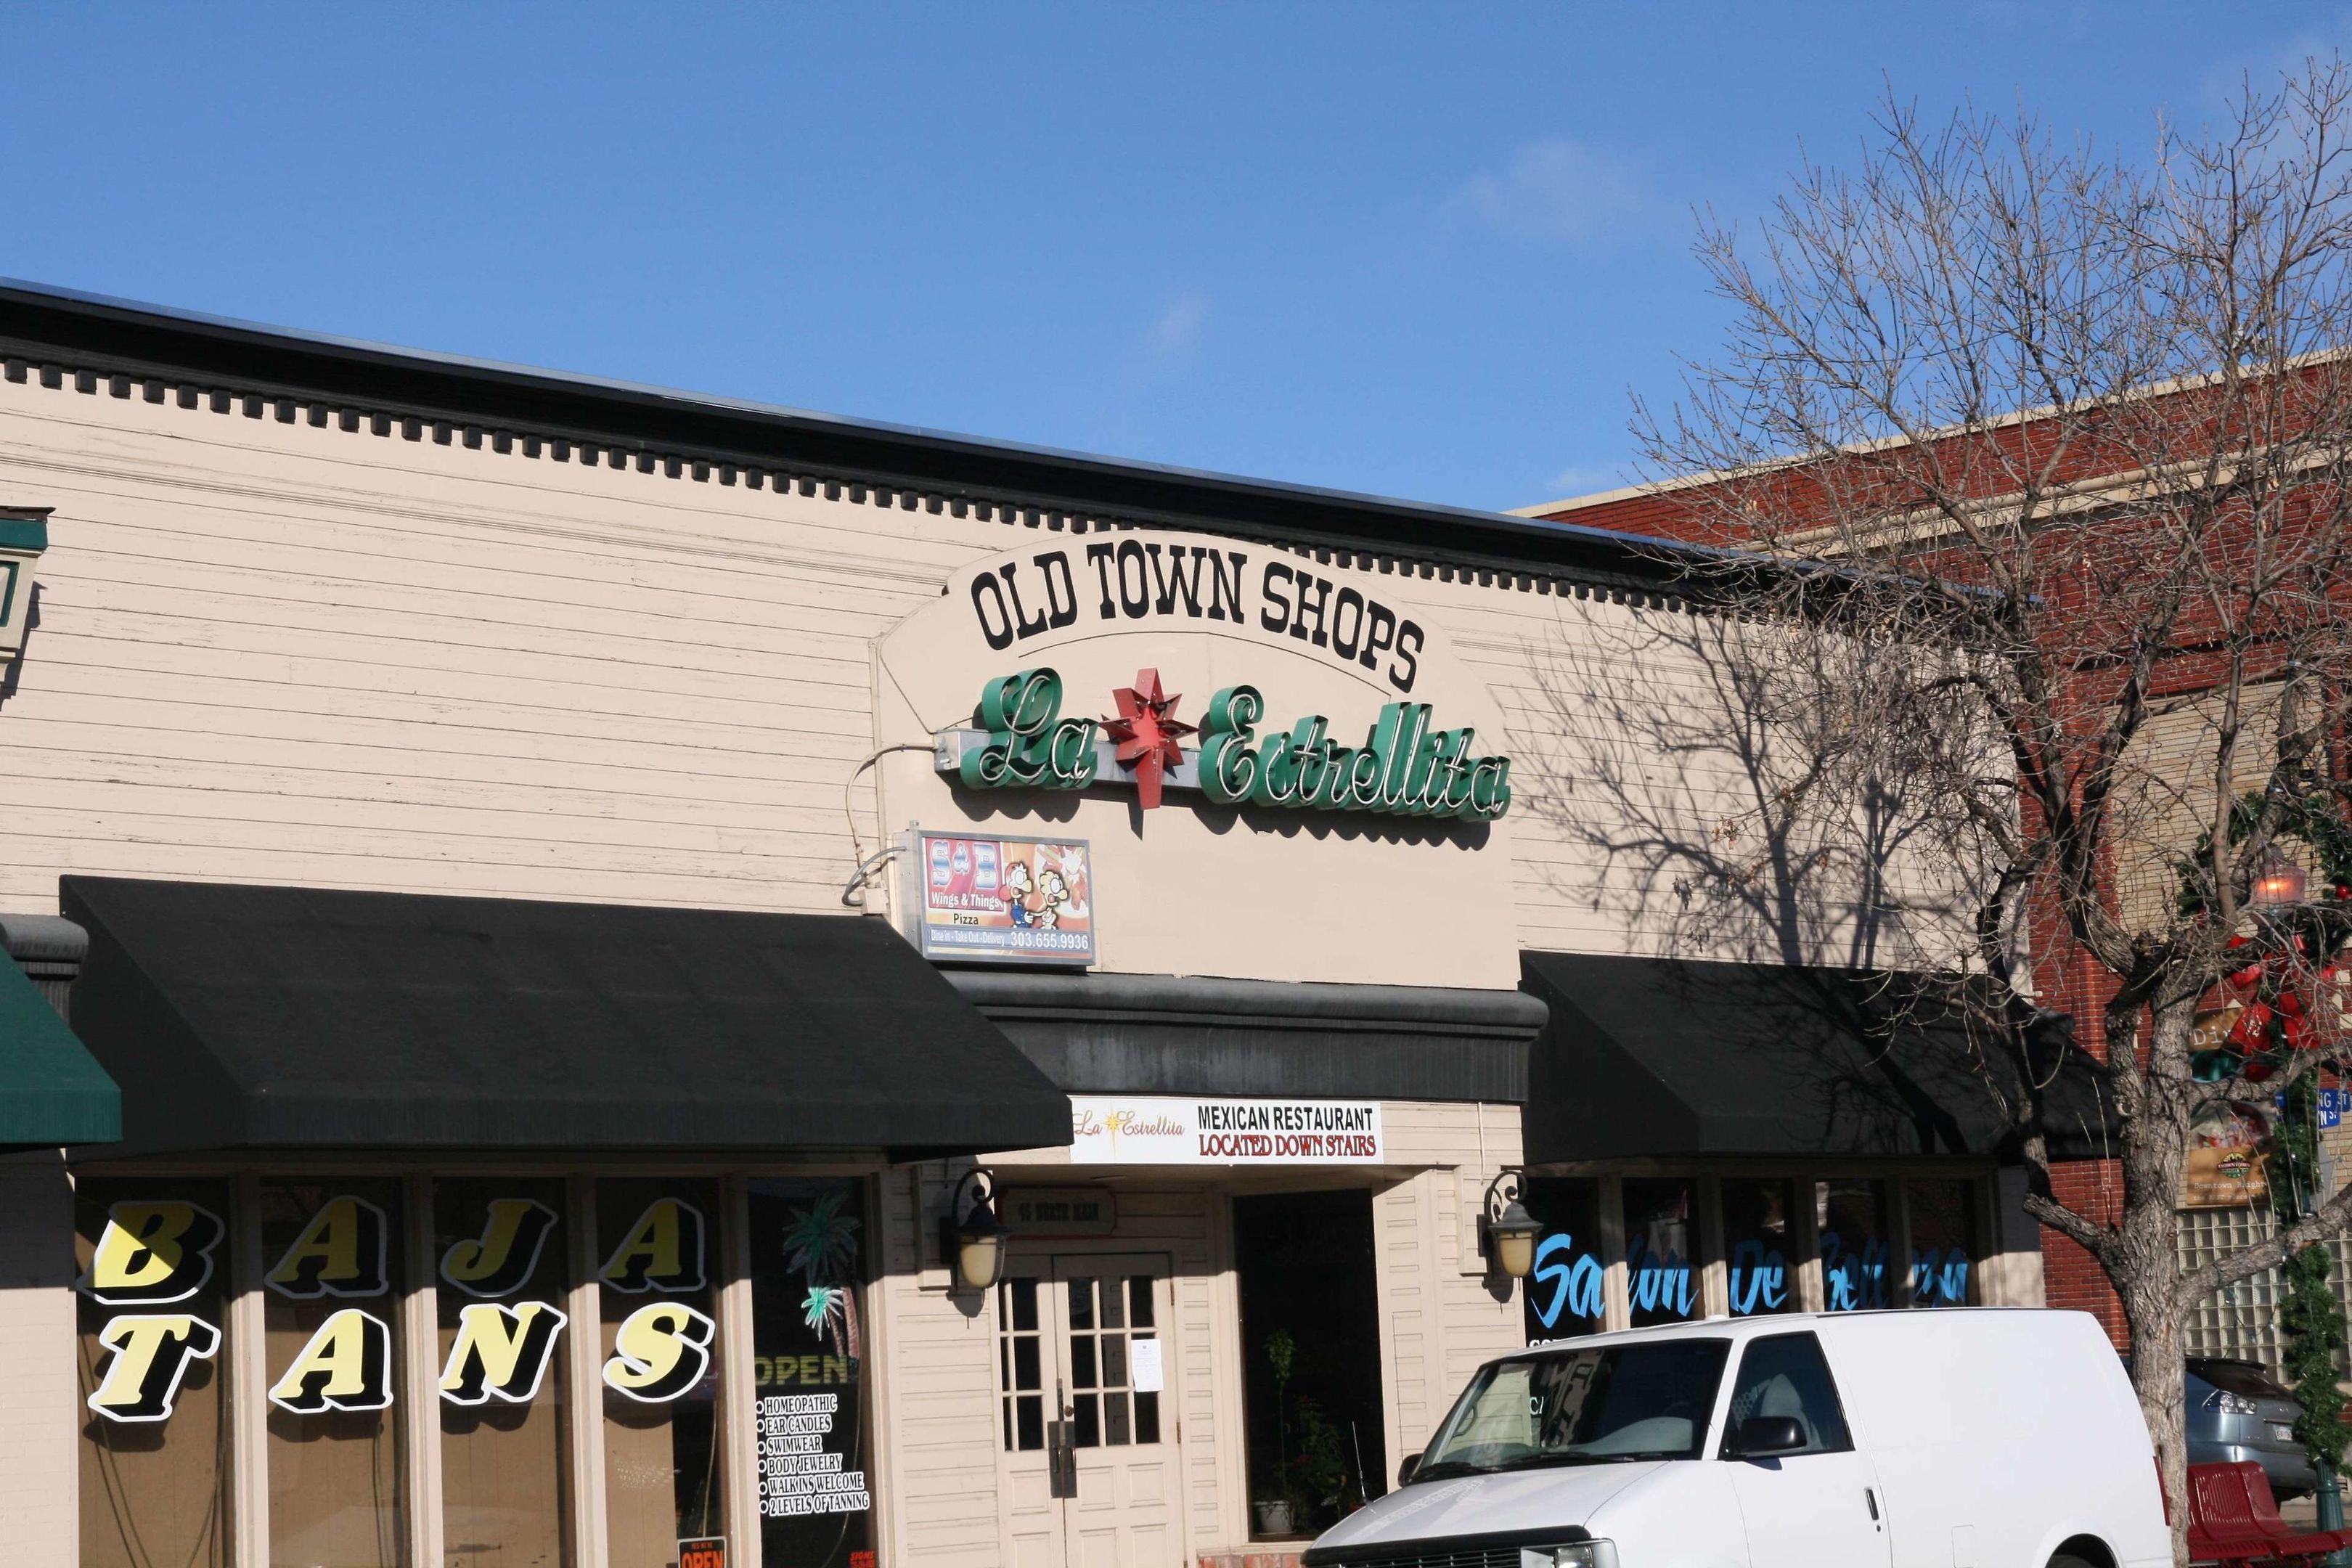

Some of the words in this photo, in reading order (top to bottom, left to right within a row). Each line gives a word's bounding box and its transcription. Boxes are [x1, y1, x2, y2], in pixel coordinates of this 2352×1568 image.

[971, 550, 1078, 651] OLD
[1087, 539, 1247, 624] TOWN
[1260, 561, 1425, 694] SHOPS
[960, 667, 1097, 791] La
[931, 841, 951, 886] S
[952, 842, 971, 873] &
[973, 843, 997, 889] B
[932, 892, 959, 907] Wings
[961, 894, 968, 906] &
[971, 894, 1000, 910] Things
[953, 913, 979, 925] Pizza
[955, 931, 968, 942] Take
[968, 931, 979, 942] Out
[1010, 931, 1088, 950] 303.655.9936
[1073, 1110, 1102, 1135] La
[1117, 1111, 1185, 1135] Estrellita
[1198, 1106, 1269, 1130] MEXICAN
[1274, 1106, 1373, 1131] RESTAURANT
[1199, 1134, 1273, 1156] LOCATED
[1275, 1135, 1323, 1157] DOWN
[1326, 1135, 1377, 1156] STAIRS
[76, 1196, 706, 1304] BAJA
[1730, 1238, 1789, 1315] De
[88, 1302, 716, 1422] TANS
[755, 1355, 848, 1386] OPEN
[765, 1395, 837, 1414] HOMEOPATHIC
[766, 1417, 786, 1434] EAR
[788, 1415, 831, 1433] CANDLES
[767, 1436, 822, 1455] SWIMWEAR
[768, 1458, 797, 1475] BODY
[799, 1454, 842, 1474] JEWELRY
[769, 1477, 798, 1495] WALK
[799, 1475, 814, 1493] INS
[816, 1473, 863, 1490] WELCOME
[770, 1498, 777, 1515] 2
[778, 1495, 812, 1514] LEVELS
[814, 1494, 828, 1511] OF
[828, 1493, 869, 1511] TANNING
[682, 1551, 723, 1568] OPEN
